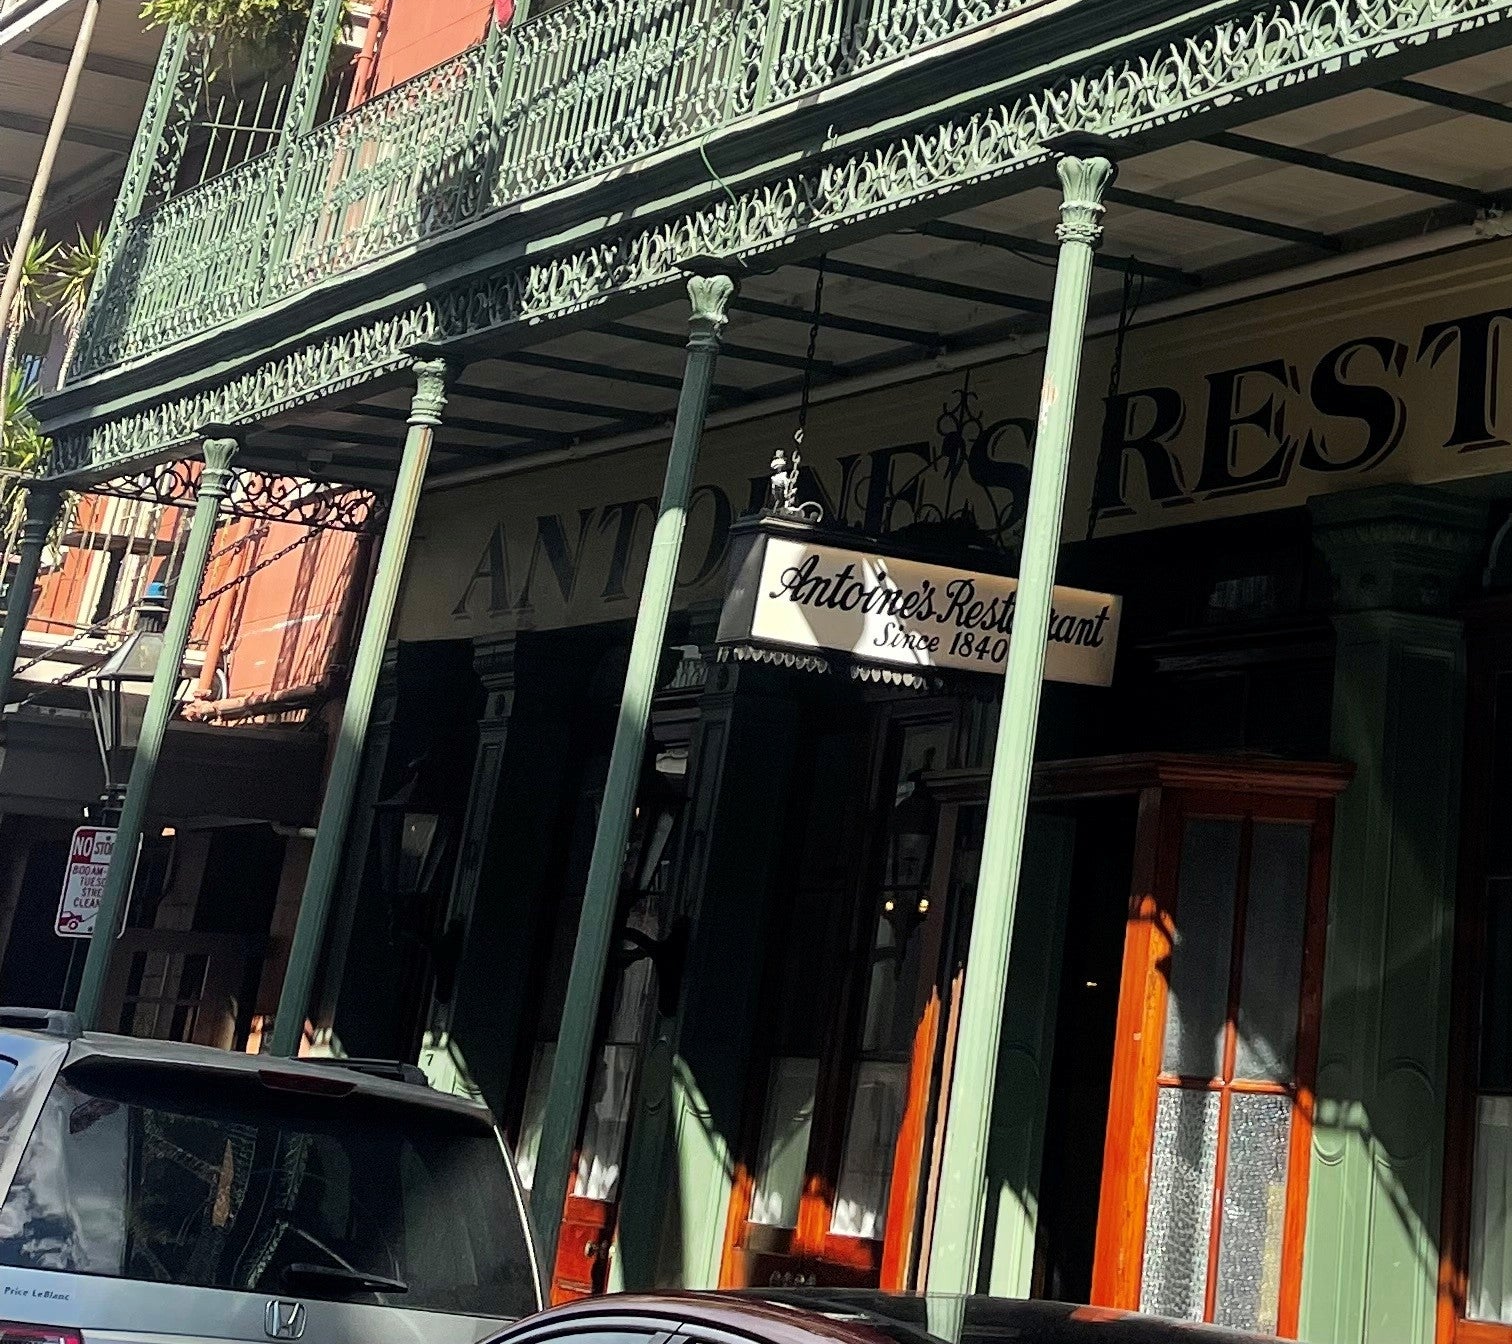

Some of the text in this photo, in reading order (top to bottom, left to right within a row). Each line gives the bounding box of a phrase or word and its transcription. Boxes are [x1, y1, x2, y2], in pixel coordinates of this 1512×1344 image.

[769, 554, 1110, 647] Antoine's Restrant
[874, 622, 1008, 663] Since 1840
[73, 836, 93, 857] NO
